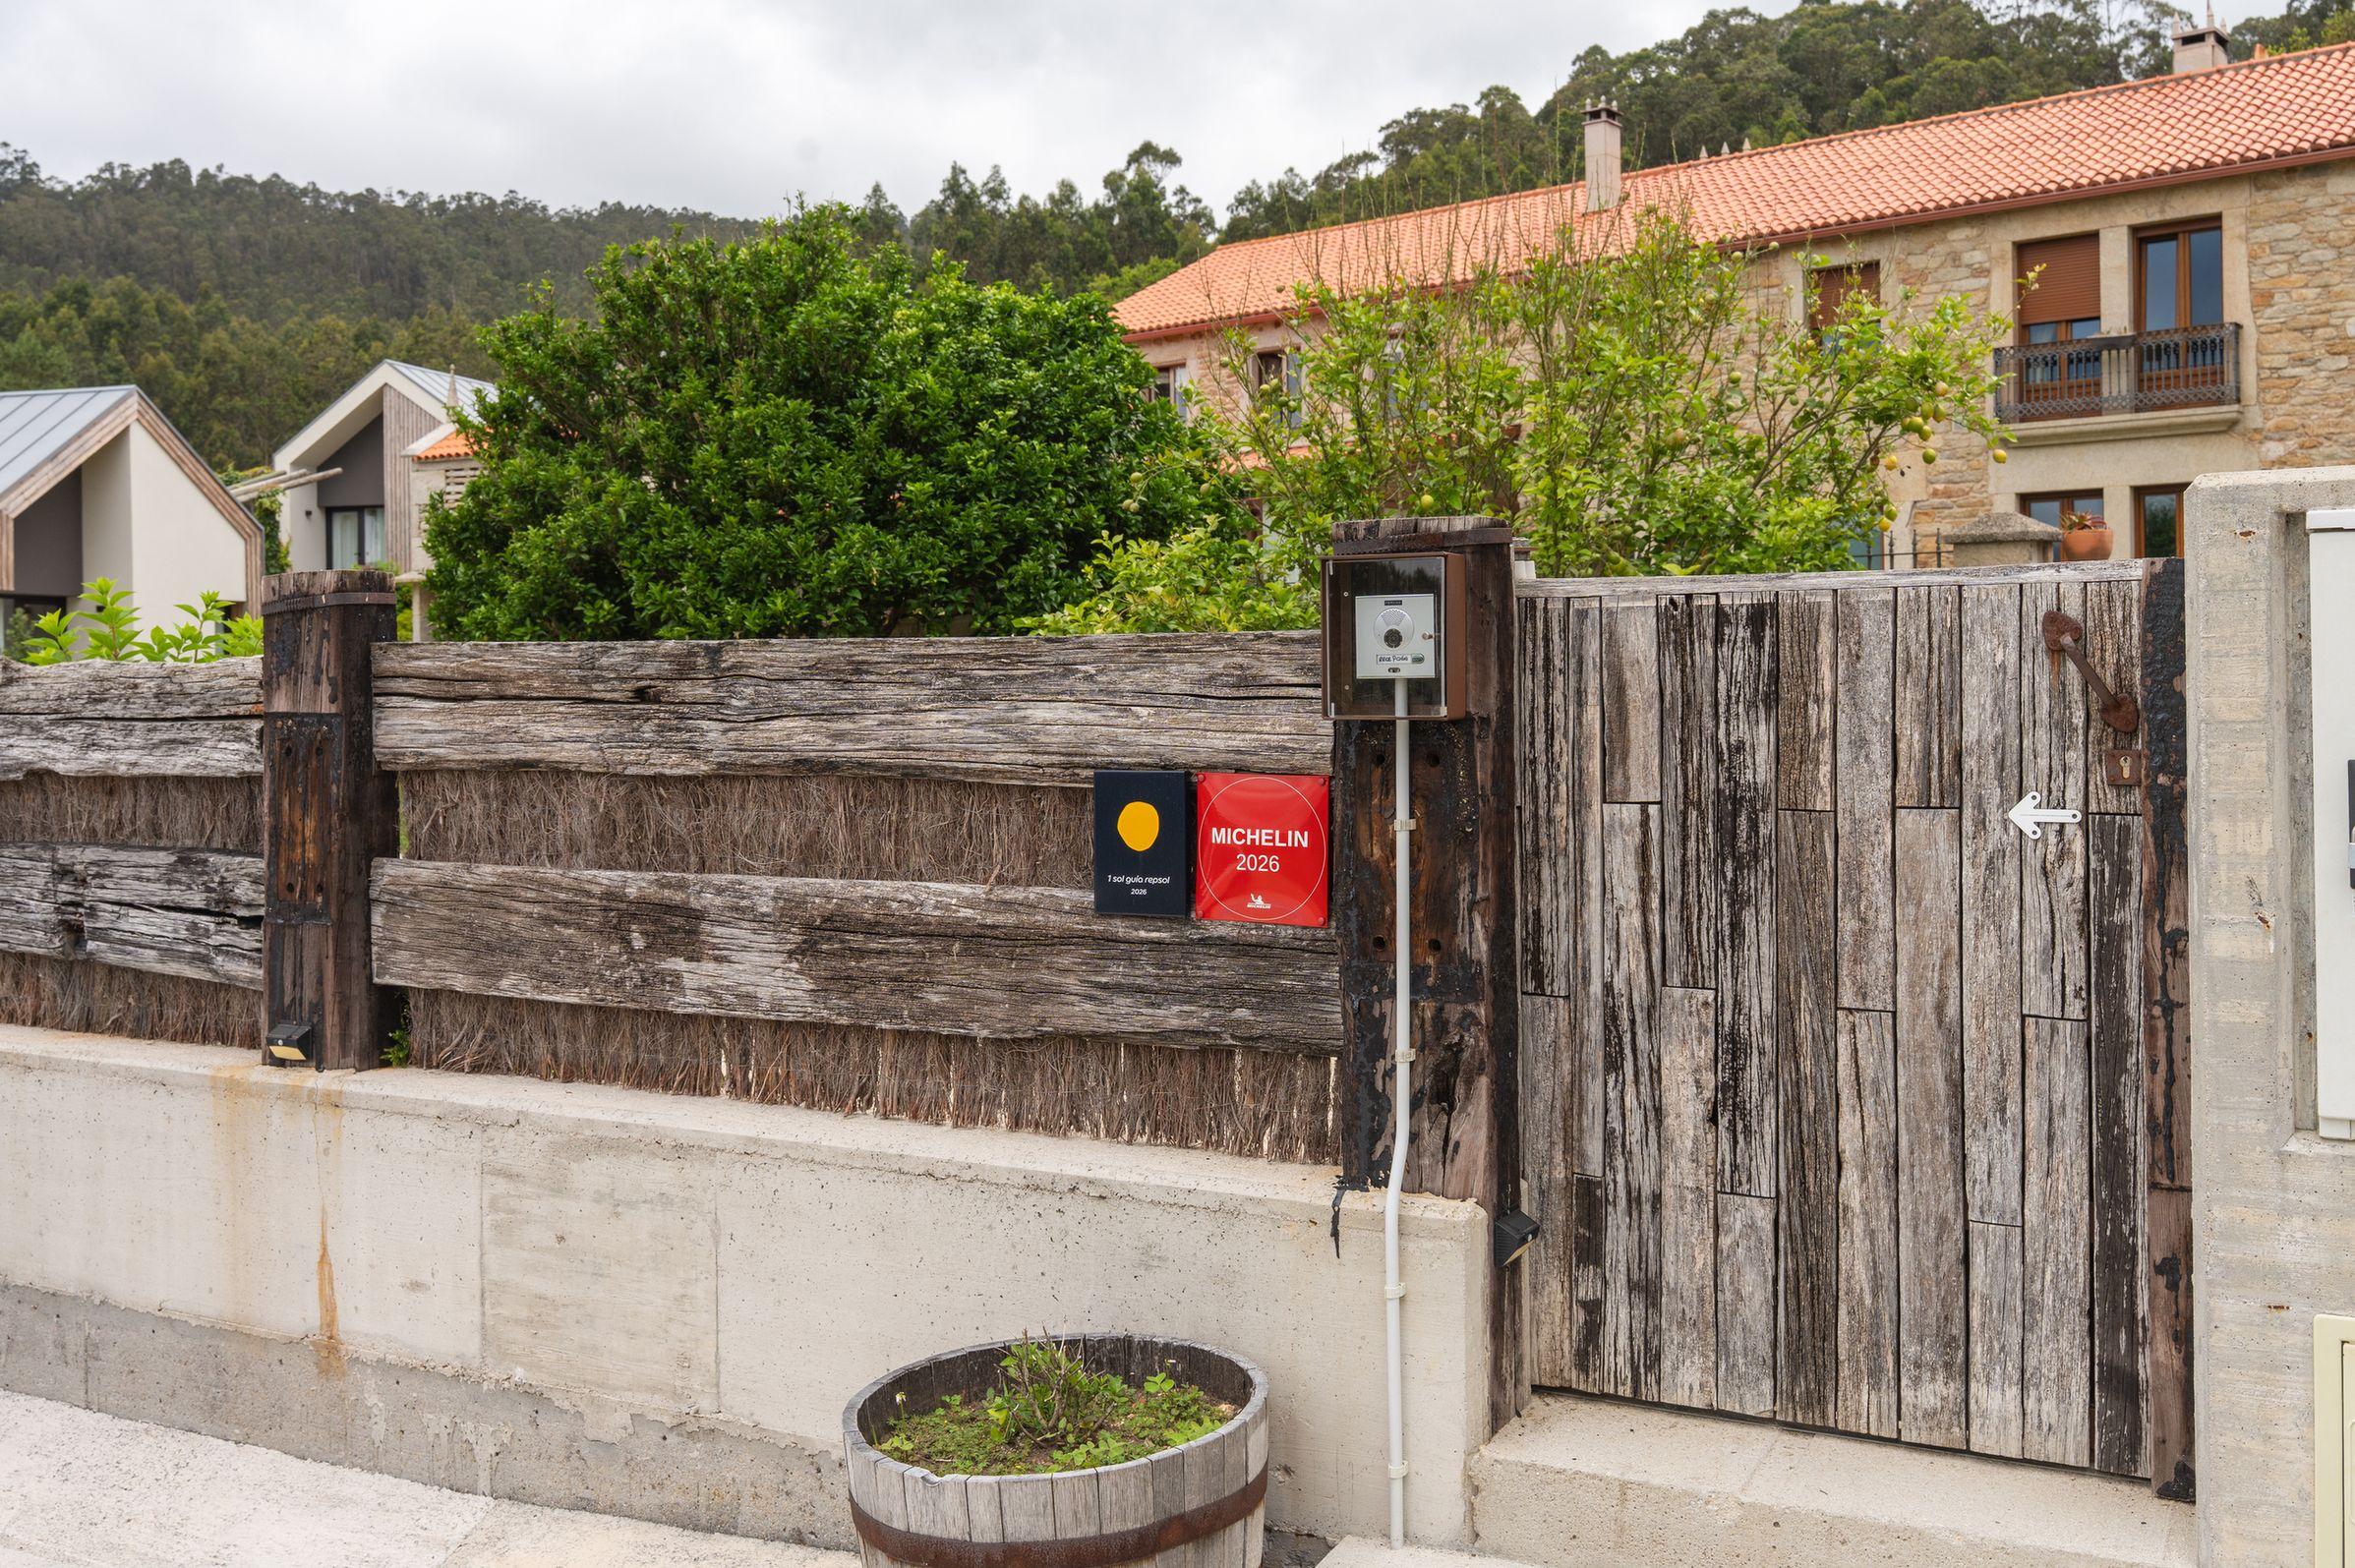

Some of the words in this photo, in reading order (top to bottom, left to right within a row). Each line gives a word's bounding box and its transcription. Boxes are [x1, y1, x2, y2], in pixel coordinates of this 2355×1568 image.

[1211, 827, 1309, 847] MICHELIN
[1236, 853, 1280, 872] 2026
[1107, 874, 1112, 883] 1
[1125, 875, 1144, 885] guía
[1145, 876, 1170, 885] repsol
